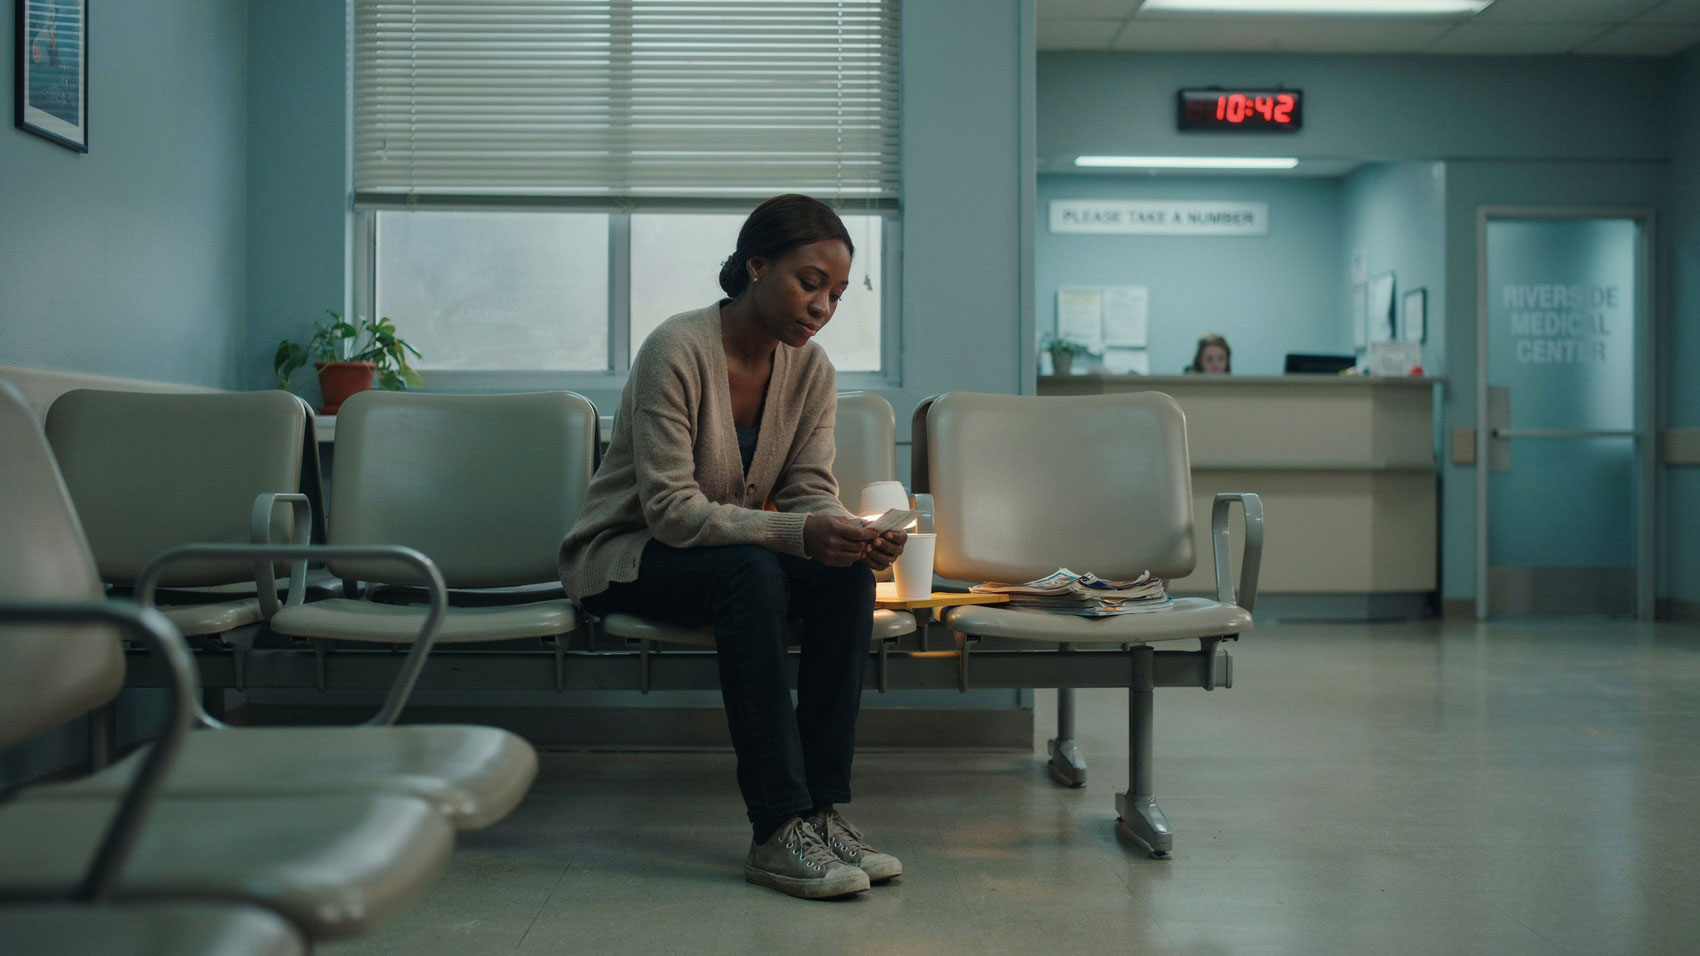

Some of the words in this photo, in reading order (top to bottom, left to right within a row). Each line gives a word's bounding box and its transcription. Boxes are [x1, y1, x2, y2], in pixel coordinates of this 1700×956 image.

[1216, 94, 1294, 123] 10:42
[1062, 208, 1121, 224] PLEASE
[1128, 208, 1167, 224] TAKE
[1171, 208, 1182, 224] A
[1187, 209, 1255, 225] NUMBER
[1502, 283, 1618, 309] RIVERSDE
